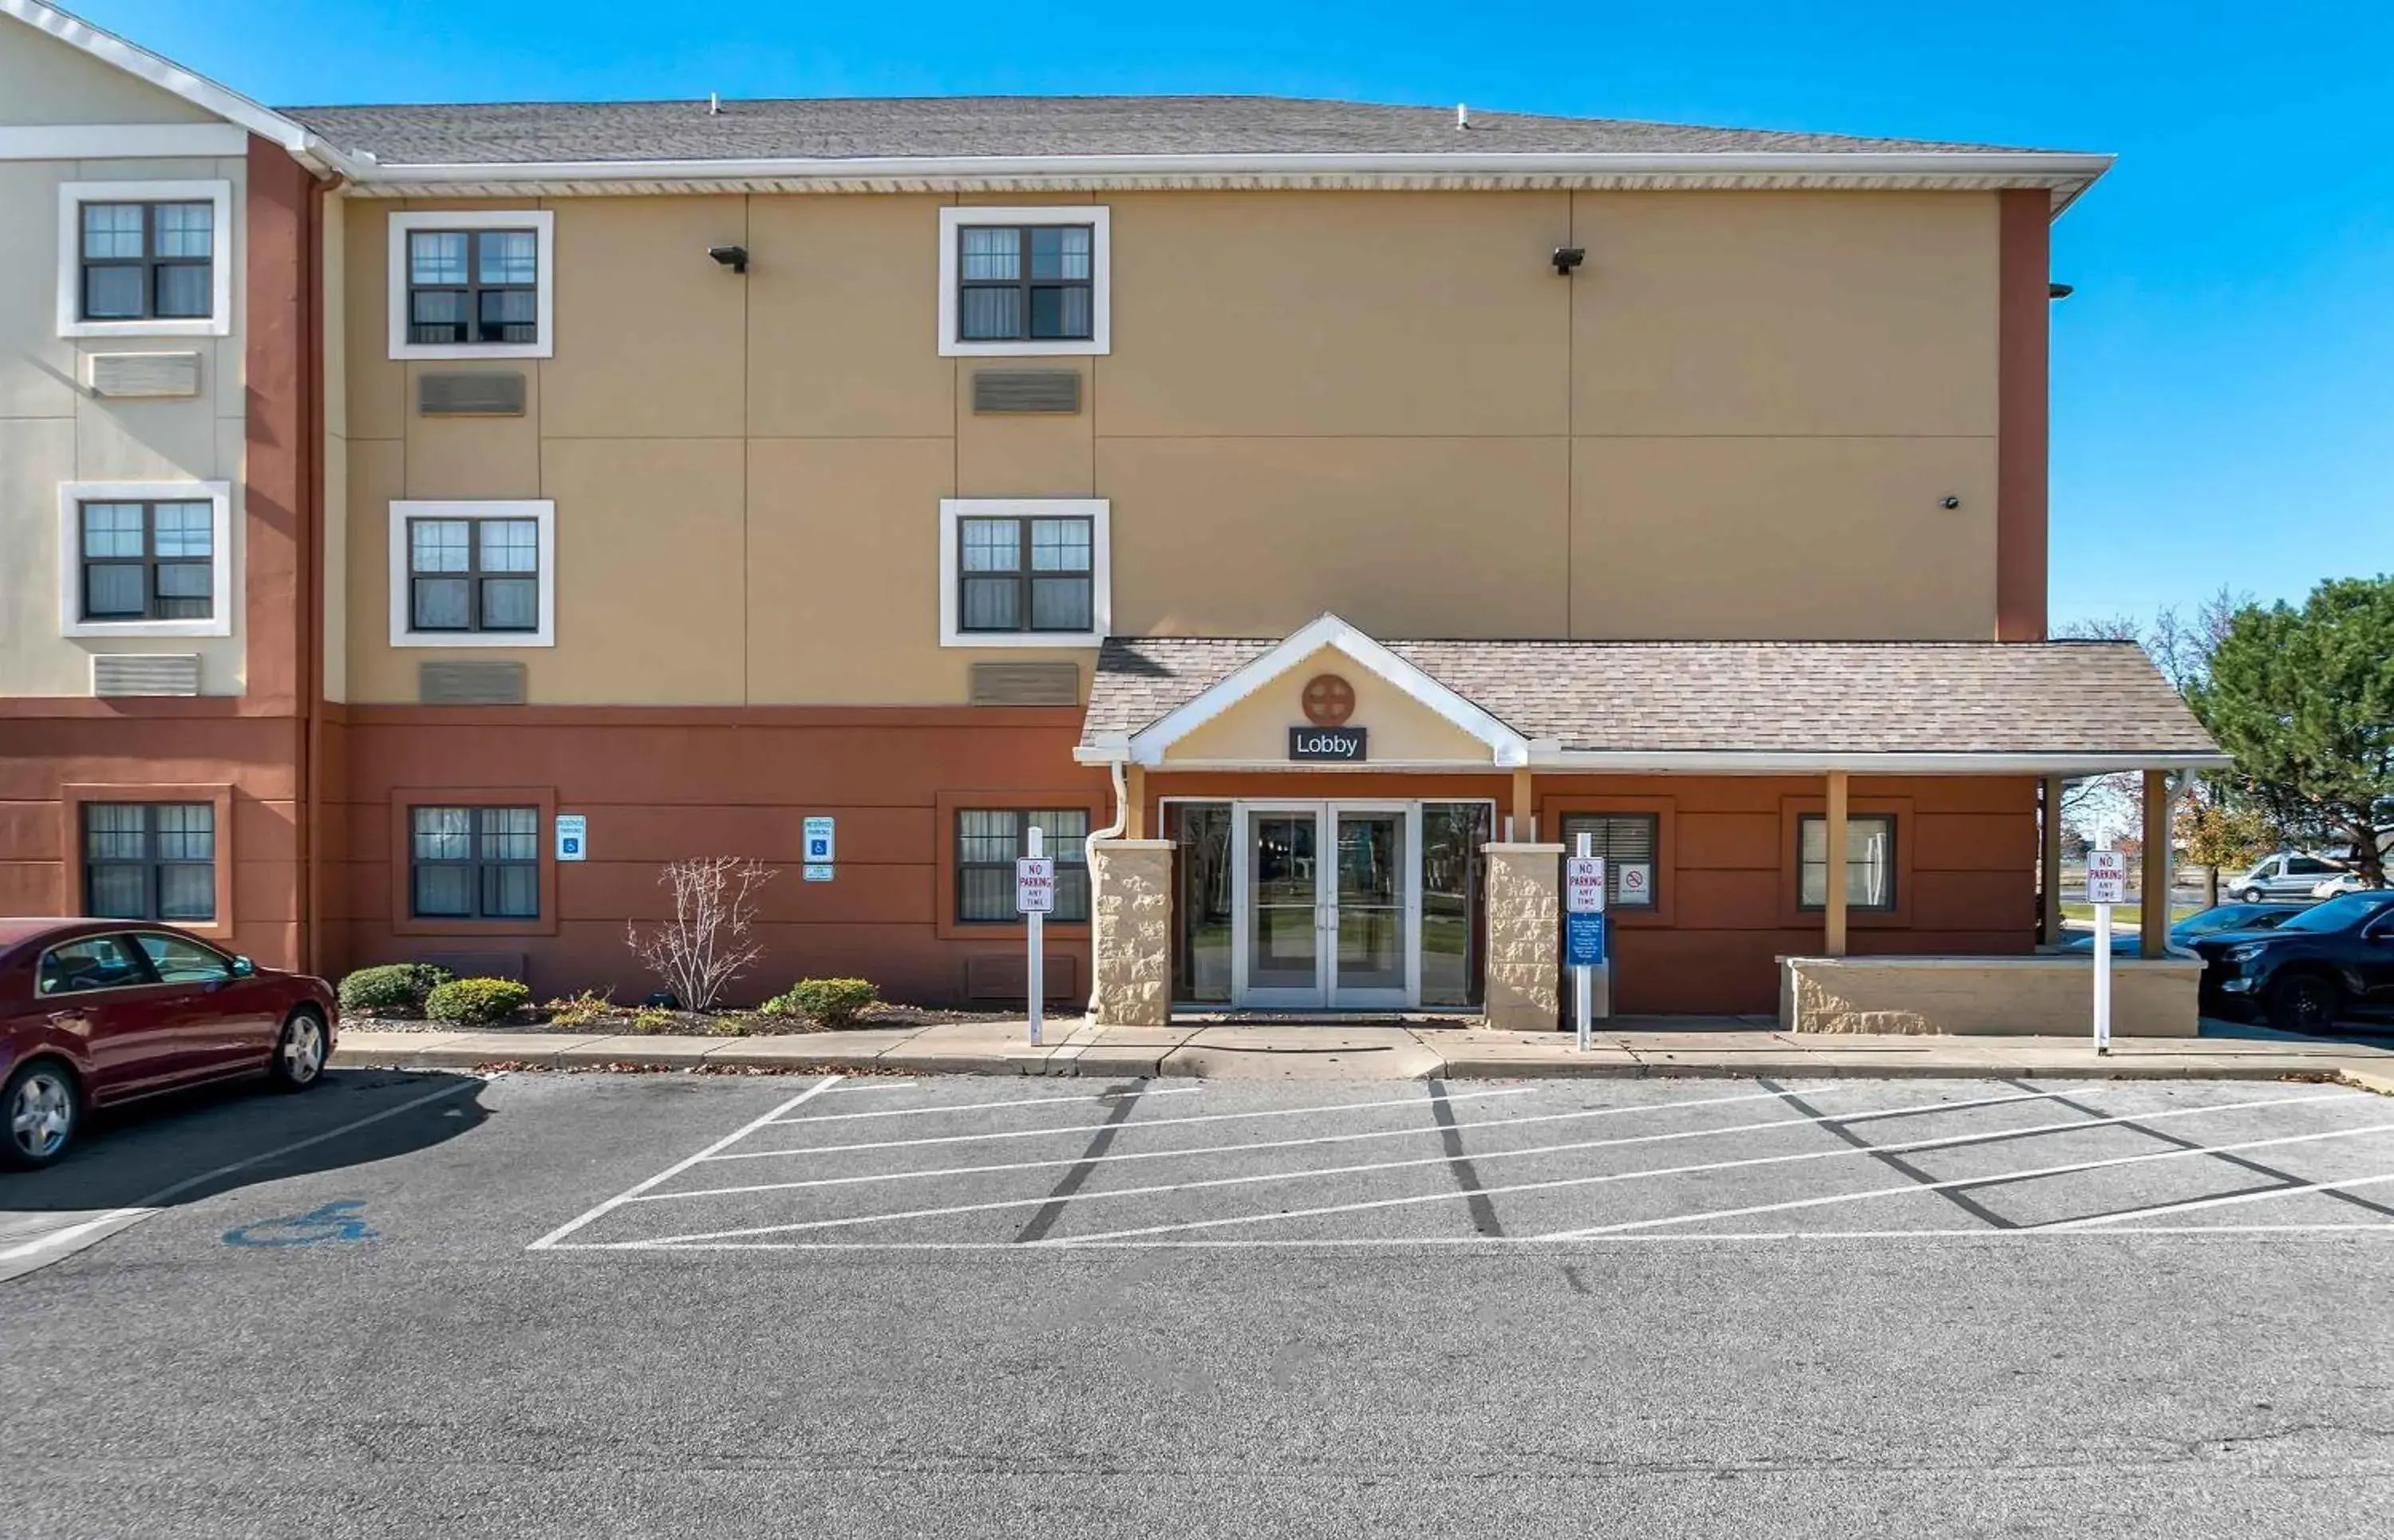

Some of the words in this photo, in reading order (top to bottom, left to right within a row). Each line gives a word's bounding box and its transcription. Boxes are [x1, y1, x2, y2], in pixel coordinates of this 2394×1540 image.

[1297, 734, 1357, 757] Lobby
[2100, 856, 2114, 867] NO
[1029, 864, 1043, 875] NO
[1579, 863, 1594, 874] NO
[2090, 869, 2123, 880] PARKING
[1021, 877, 1052, 887] PARKING
[1570, 876, 1602, 886] PARKING
